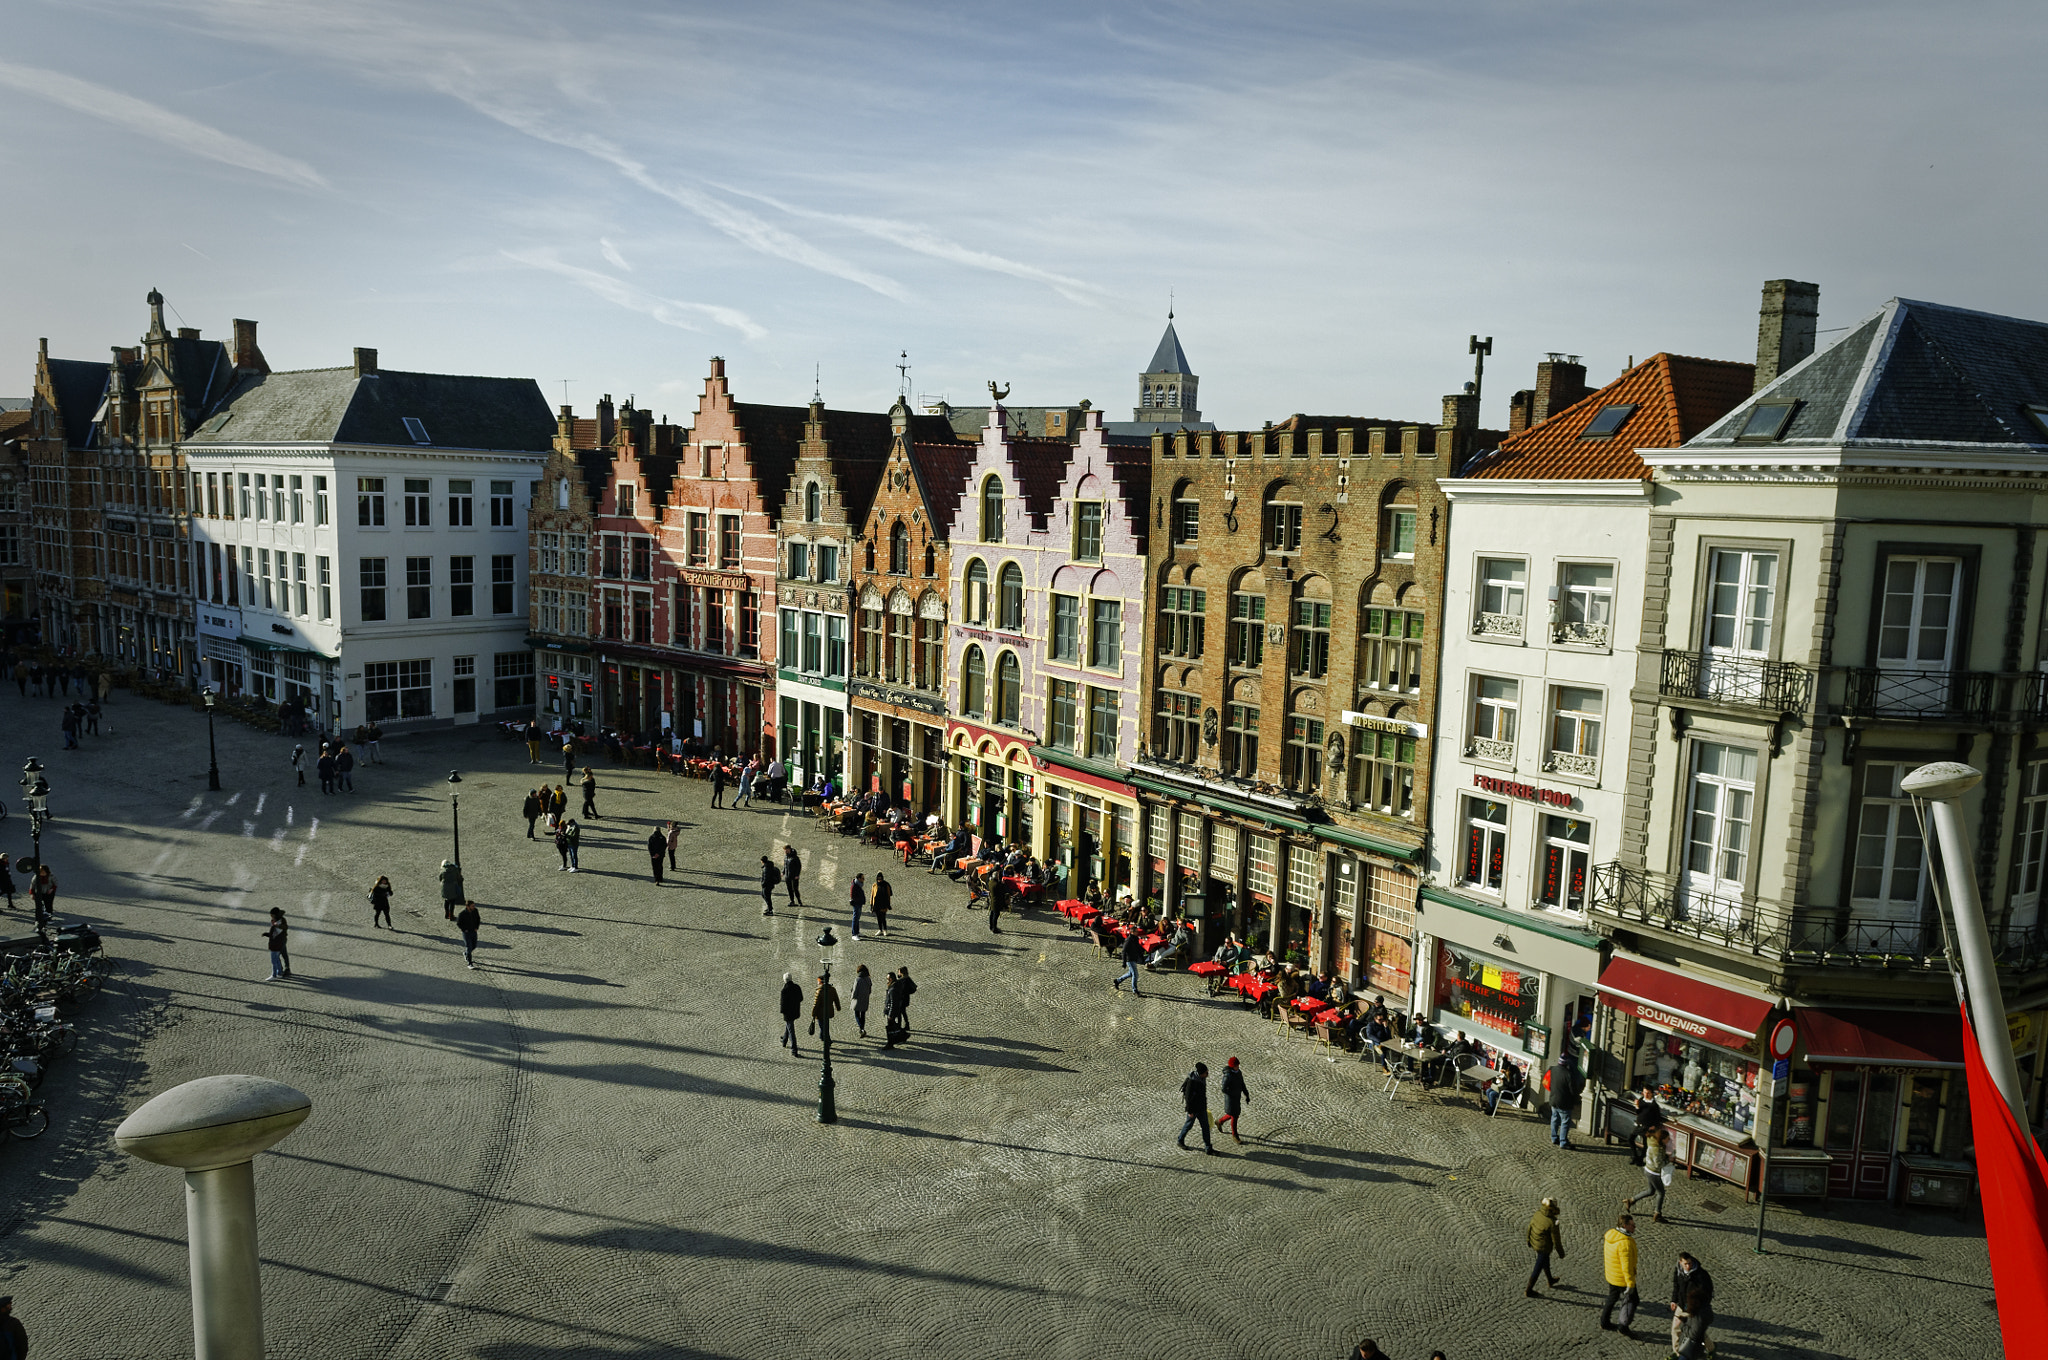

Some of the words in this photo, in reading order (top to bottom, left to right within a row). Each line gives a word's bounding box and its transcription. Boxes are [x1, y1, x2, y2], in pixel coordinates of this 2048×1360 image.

[692, 573, 722, 586] PANIER
[808, 678, 821, 686] JORIS
[1363, 719, 1384, 730] PETIT
[1474, 774, 1535, 799] FRITERIE
[1538, 789, 1571, 806] 1900
[1471, 829, 1479, 876] FRITERIE
[1494, 848, 1502, 871] 1900
[1548, 849, 1558, 898] FRITERIE
[1574, 868, 1583, 892] 1900
[1451, 977, 1489, 997] FRITERIE
[1498, 994, 1520, 1008] 1900
[1636, 1006, 1707, 1035] SOUVENIRS
[1855, 1065, 1873, 1073] M.
